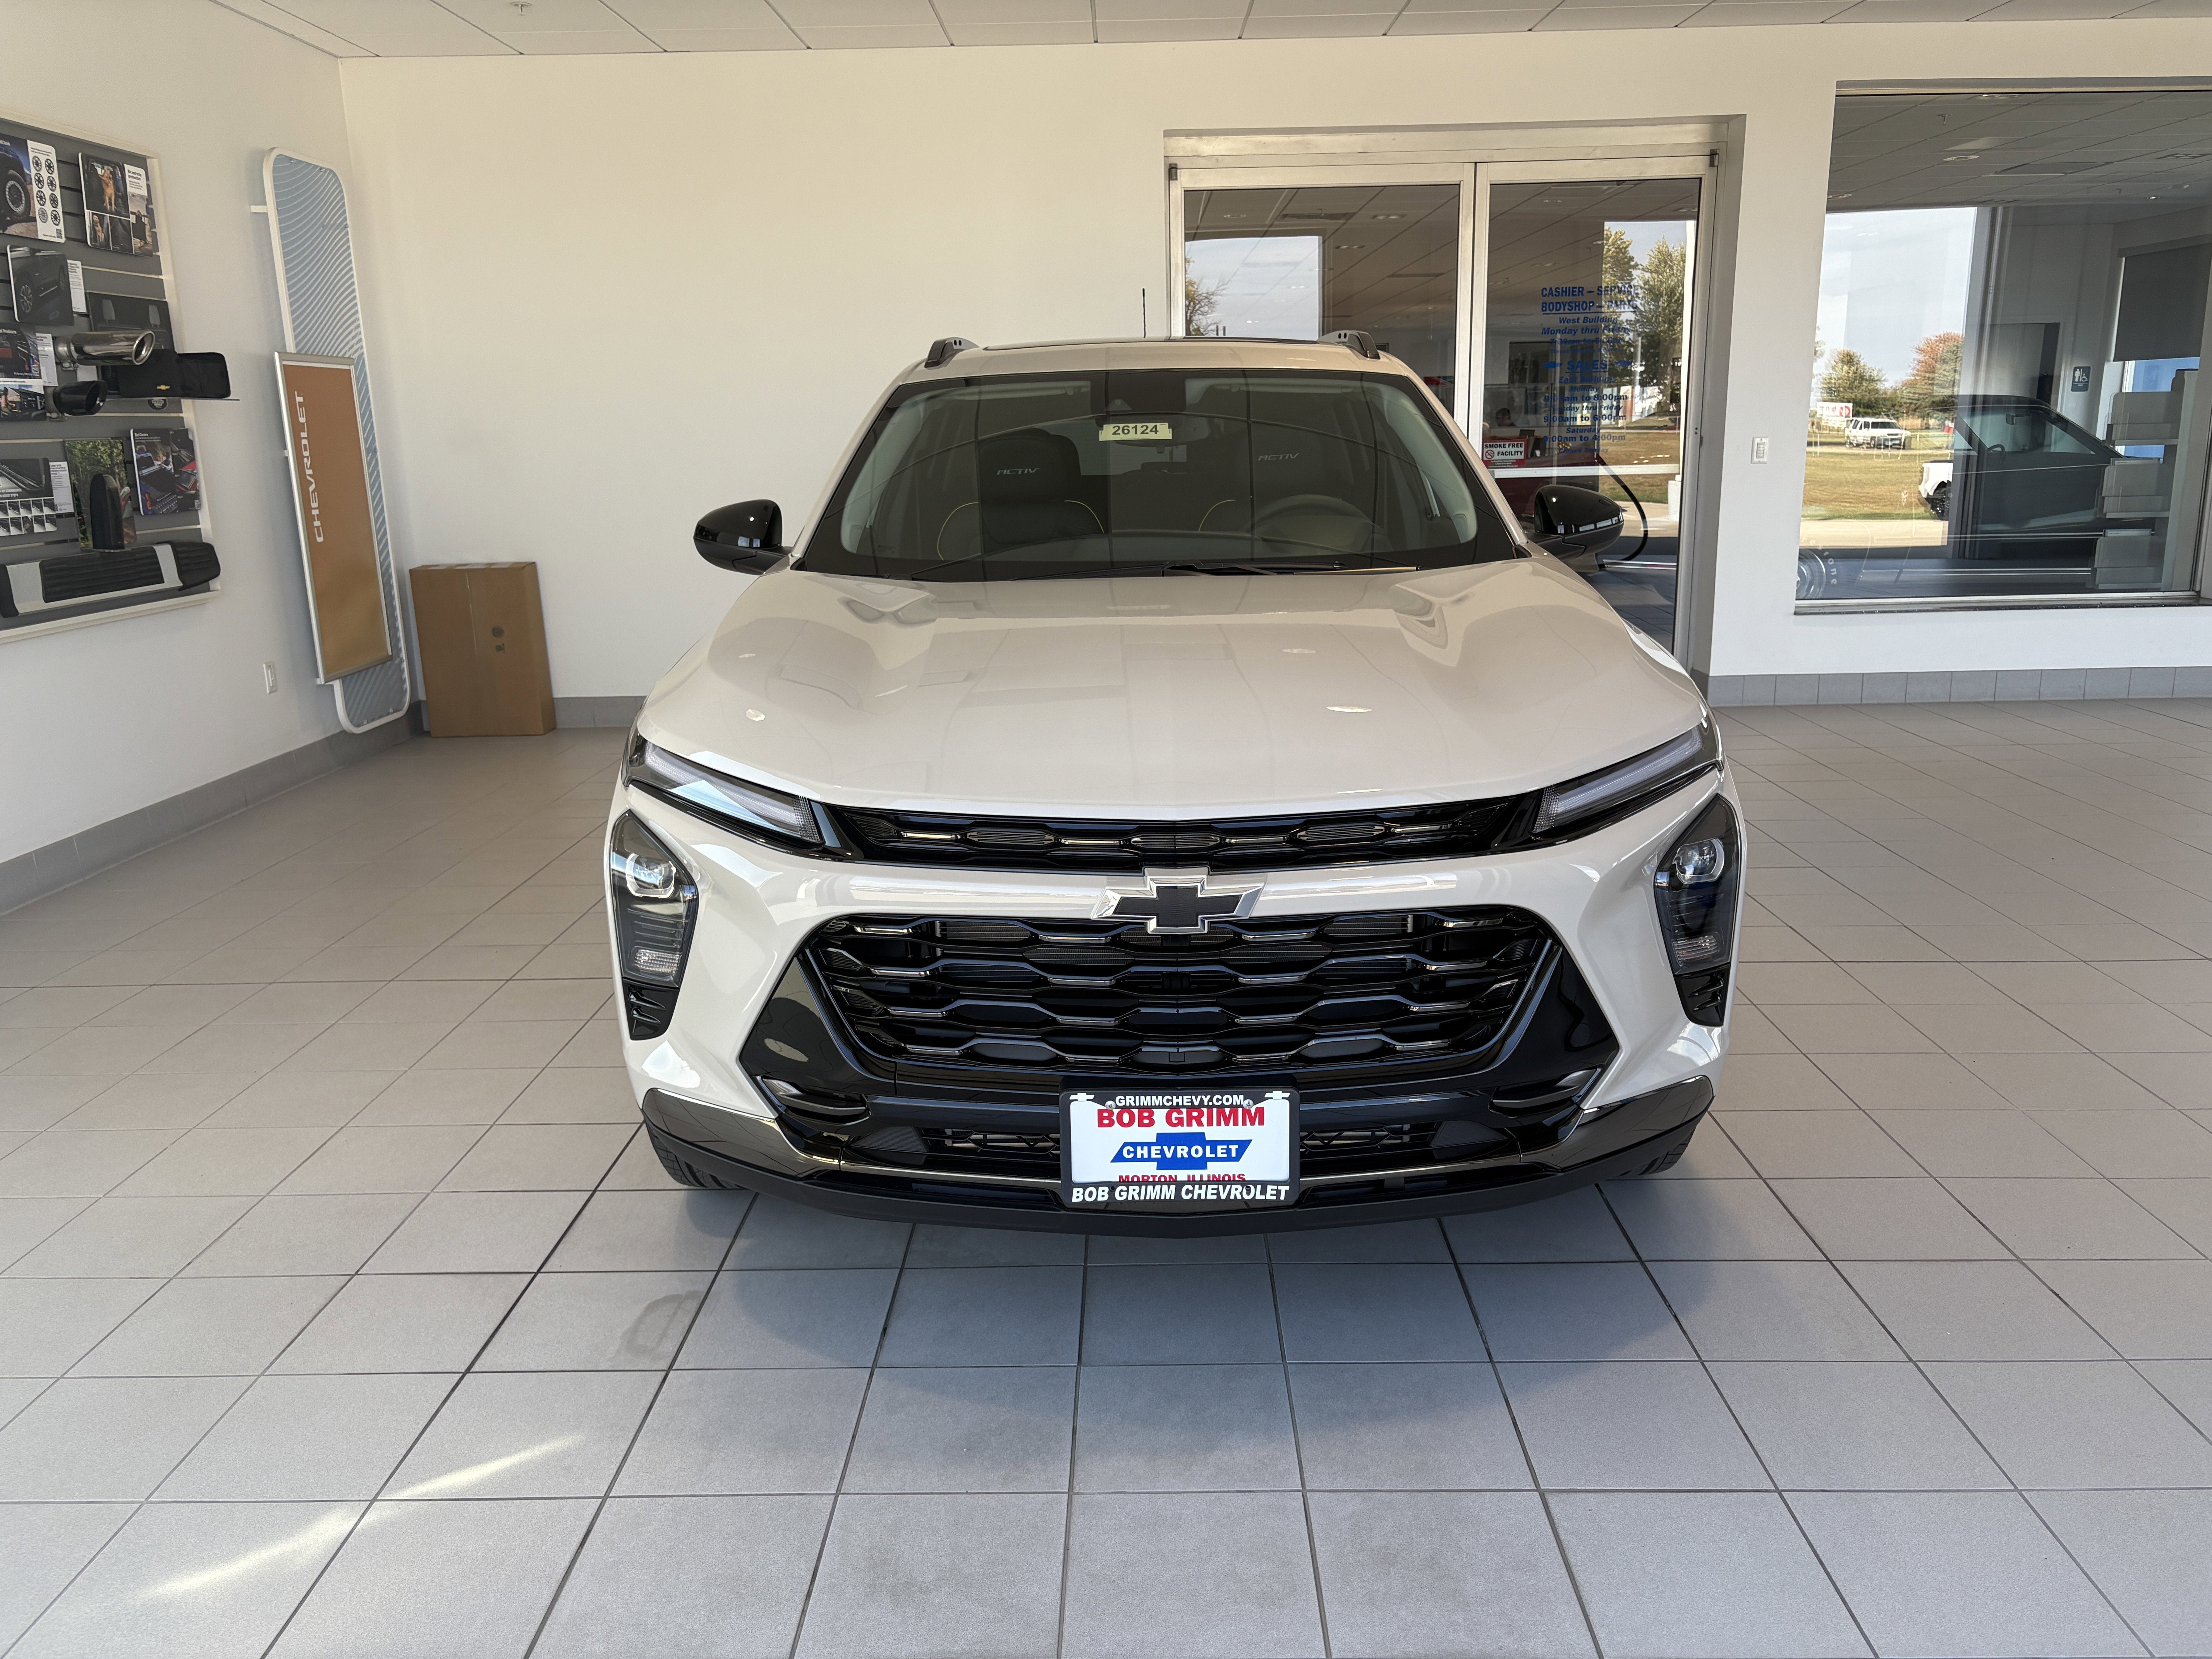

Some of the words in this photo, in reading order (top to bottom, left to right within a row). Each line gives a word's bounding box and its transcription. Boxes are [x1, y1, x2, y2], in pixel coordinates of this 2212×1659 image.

[1541, 287, 1584, 297] CASHIER
[1597, 285, 1639, 296] SERVICE
[1541, 301, 1595, 312] BODYSHOP
[1607, 300, 1638, 310] PARTS
[1583, 316, 1618, 324] Building
[1541, 328, 1578, 336] Monday
[1567, 360, 1608, 370] SALES
[1594, 393, 1628, 402] 8:00pm
[1593, 414, 1627, 422] 6:00pm
[1112, 424, 1159, 436] 26124
[1592, 434, 1626, 442] 4:00pm
[1258, 453, 1300, 461] ACTIV
[295, 391, 324, 542] CHEVROLET
[1115, 1094, 1244, 1107] GRIMMCHEVY.COM
[1097, 1108, 1155, 1128] BOB
[1165, 1107, 1265, 1127] GRIMM
[1122, 1144, 1239, 1159] CHEVROLET
[1187, 1173, 1246, 1182] ILLINOIS
[1072, 1186, 1109, 1202] BOB
[1115, 1185, 1175, 1201] GRIMM
[1181, 1184, 1290, 1201] CHEVROLET
